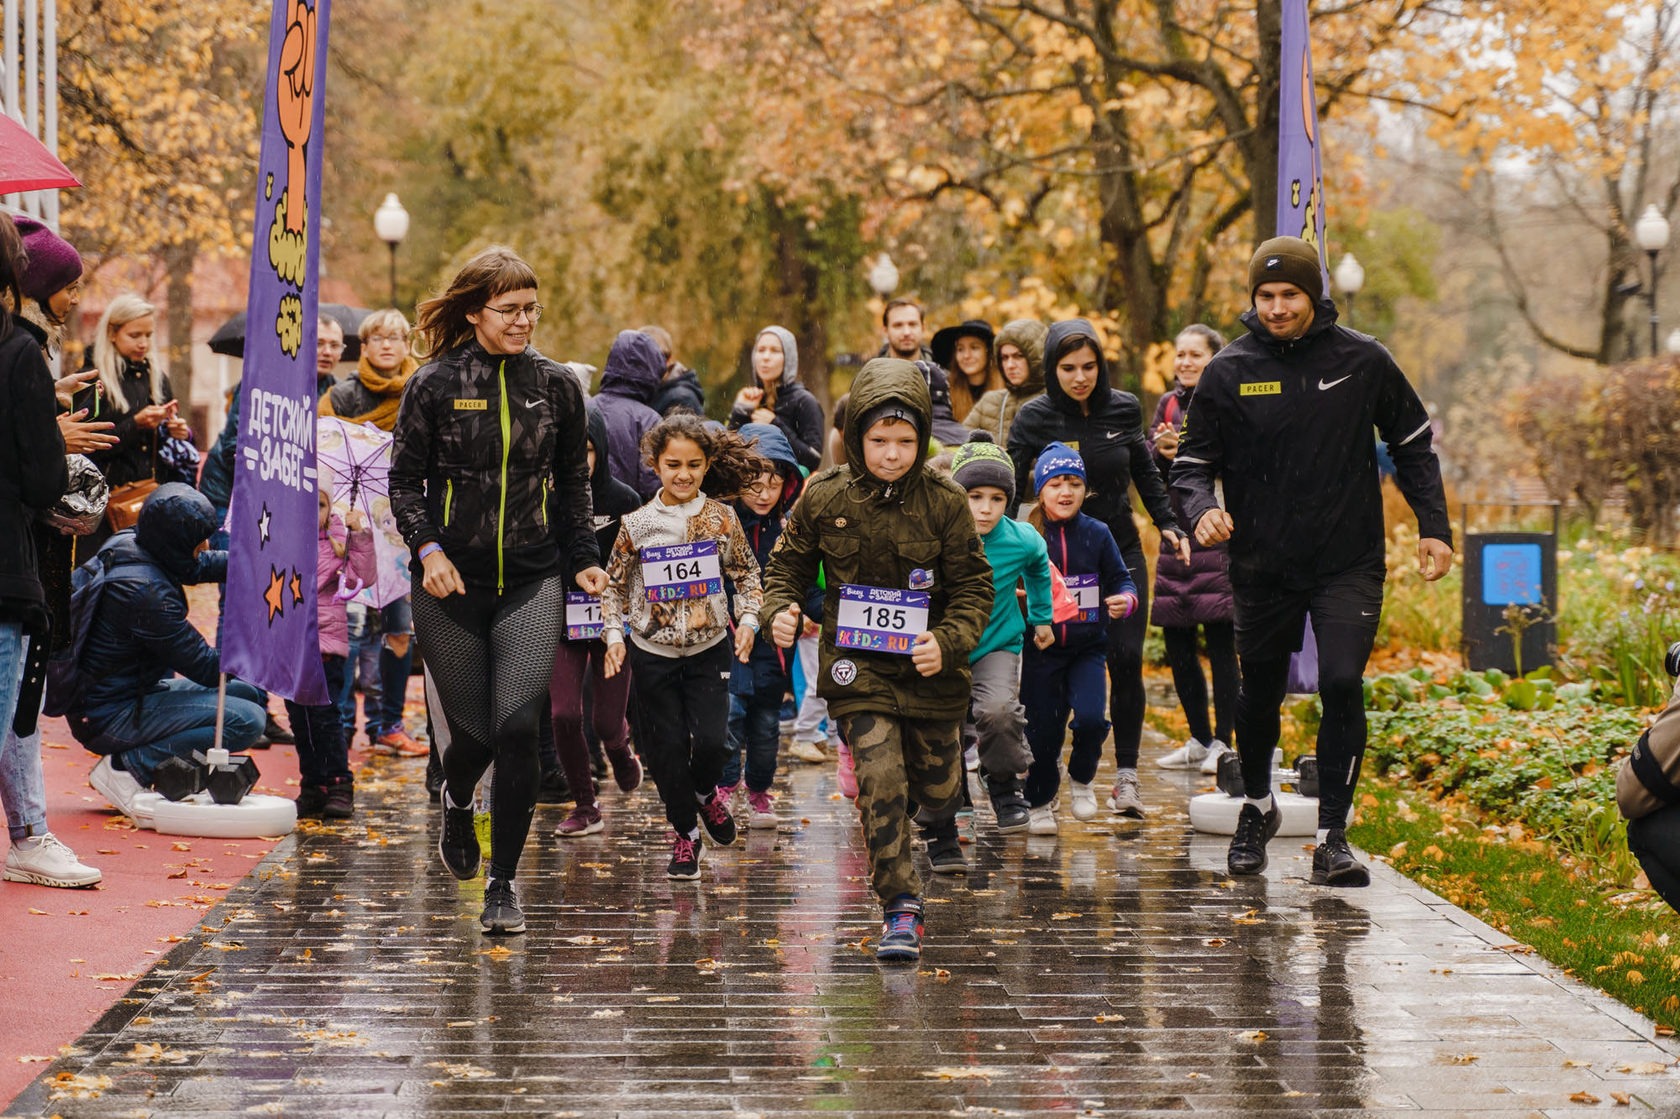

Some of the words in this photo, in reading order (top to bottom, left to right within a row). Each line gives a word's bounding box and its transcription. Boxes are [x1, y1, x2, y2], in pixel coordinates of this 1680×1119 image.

[1246, 384, 1275, 393] PACER
[248, 387, 314, 454] ДЕТСКИЙ
[260, 435, 304, 492] ЗАБЕГ
[663, 560, 701, 581] 164
[585, 606, 602, 621] 17
[863, 606, 906, 630] 185
[887, 635, 915, 651] RU
